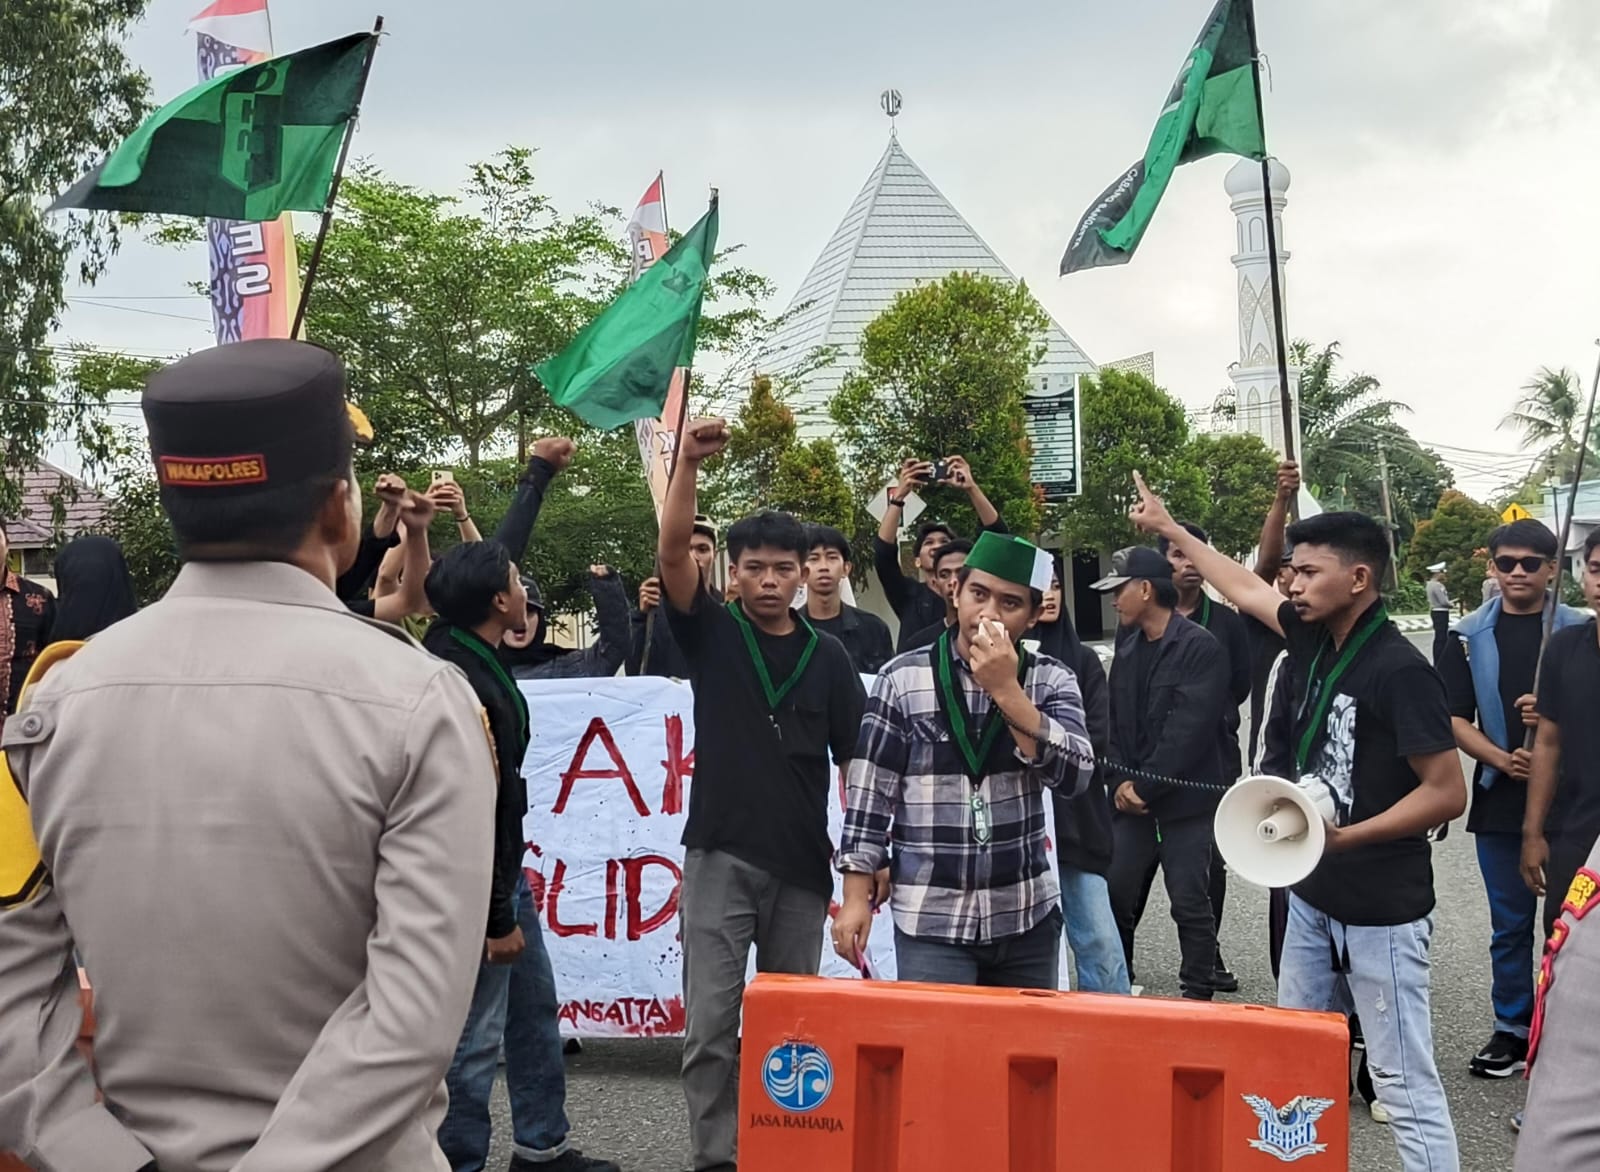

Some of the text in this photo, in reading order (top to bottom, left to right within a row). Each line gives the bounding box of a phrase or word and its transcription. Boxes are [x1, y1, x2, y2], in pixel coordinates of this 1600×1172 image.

[1105, 168, 1138, 203] CABANG
[166, 460, 260, 480] WAKAPOLRES
[551, 714, 695, 817] AK
[523, 841, 684, 941] LID
[556, 997, 671, 1028] ANGATTA
[751, 1113, 844, 1133] JASA RAHARJA
